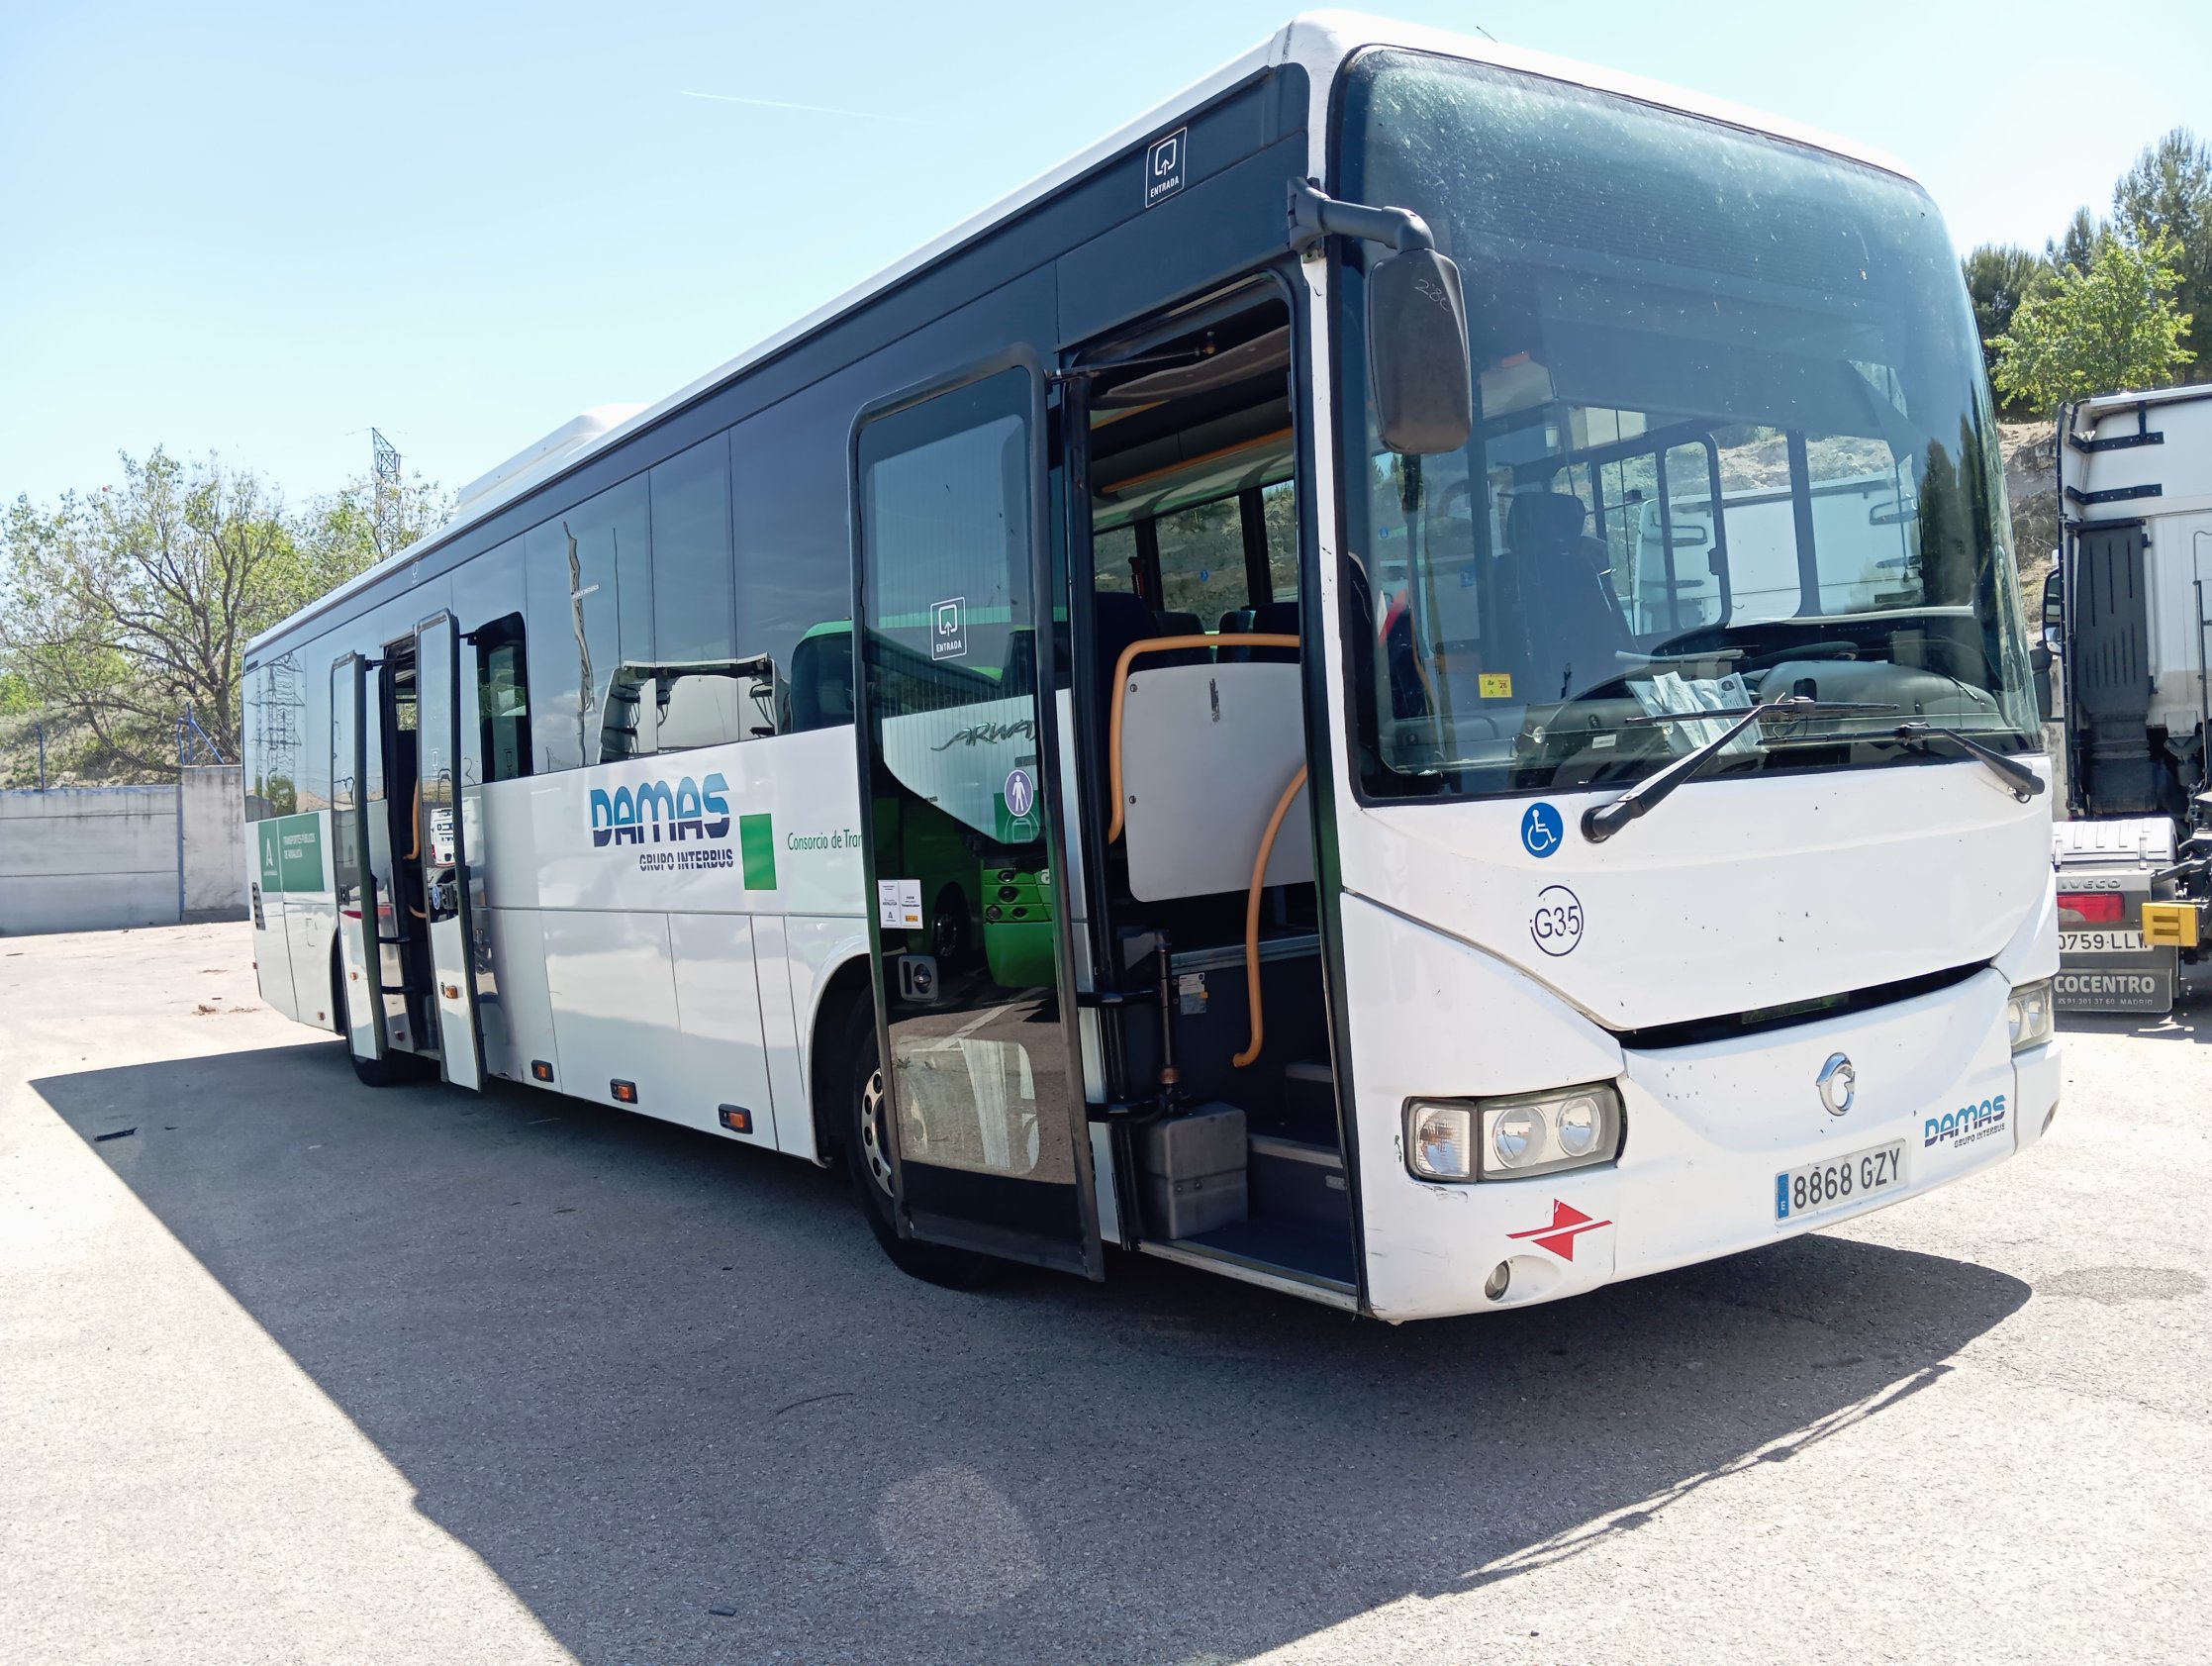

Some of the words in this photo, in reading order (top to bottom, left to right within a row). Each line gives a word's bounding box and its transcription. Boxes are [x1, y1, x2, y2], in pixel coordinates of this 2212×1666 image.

[1150, 175, 1180, 198] ENTRADA
[935, 638, 962, 653] ENTRADA
[590, 772, 730, 848] DAMAS
[787, 832, 828, 851] Consorcio
[831, 830, 842, 848] de
[639, 851, 674, 872] GRUPO
[677, 848, 734, 870] INTERBUS
[2062, 878, 2122, 890] IVECO
[1534, 905, 1581, 939] G35
[1924, 1095, 2006, 1148] DAMAS
[1954, 1133, 1975, 1148] GRUPO
[1976, 1123, 2006, 1140] INTERBUS
[1780, 1200, 1786, 1211] E
[1793, 1162, 1853, 1210] 8868
[1861, 1147, 1900, 1190] GZY
